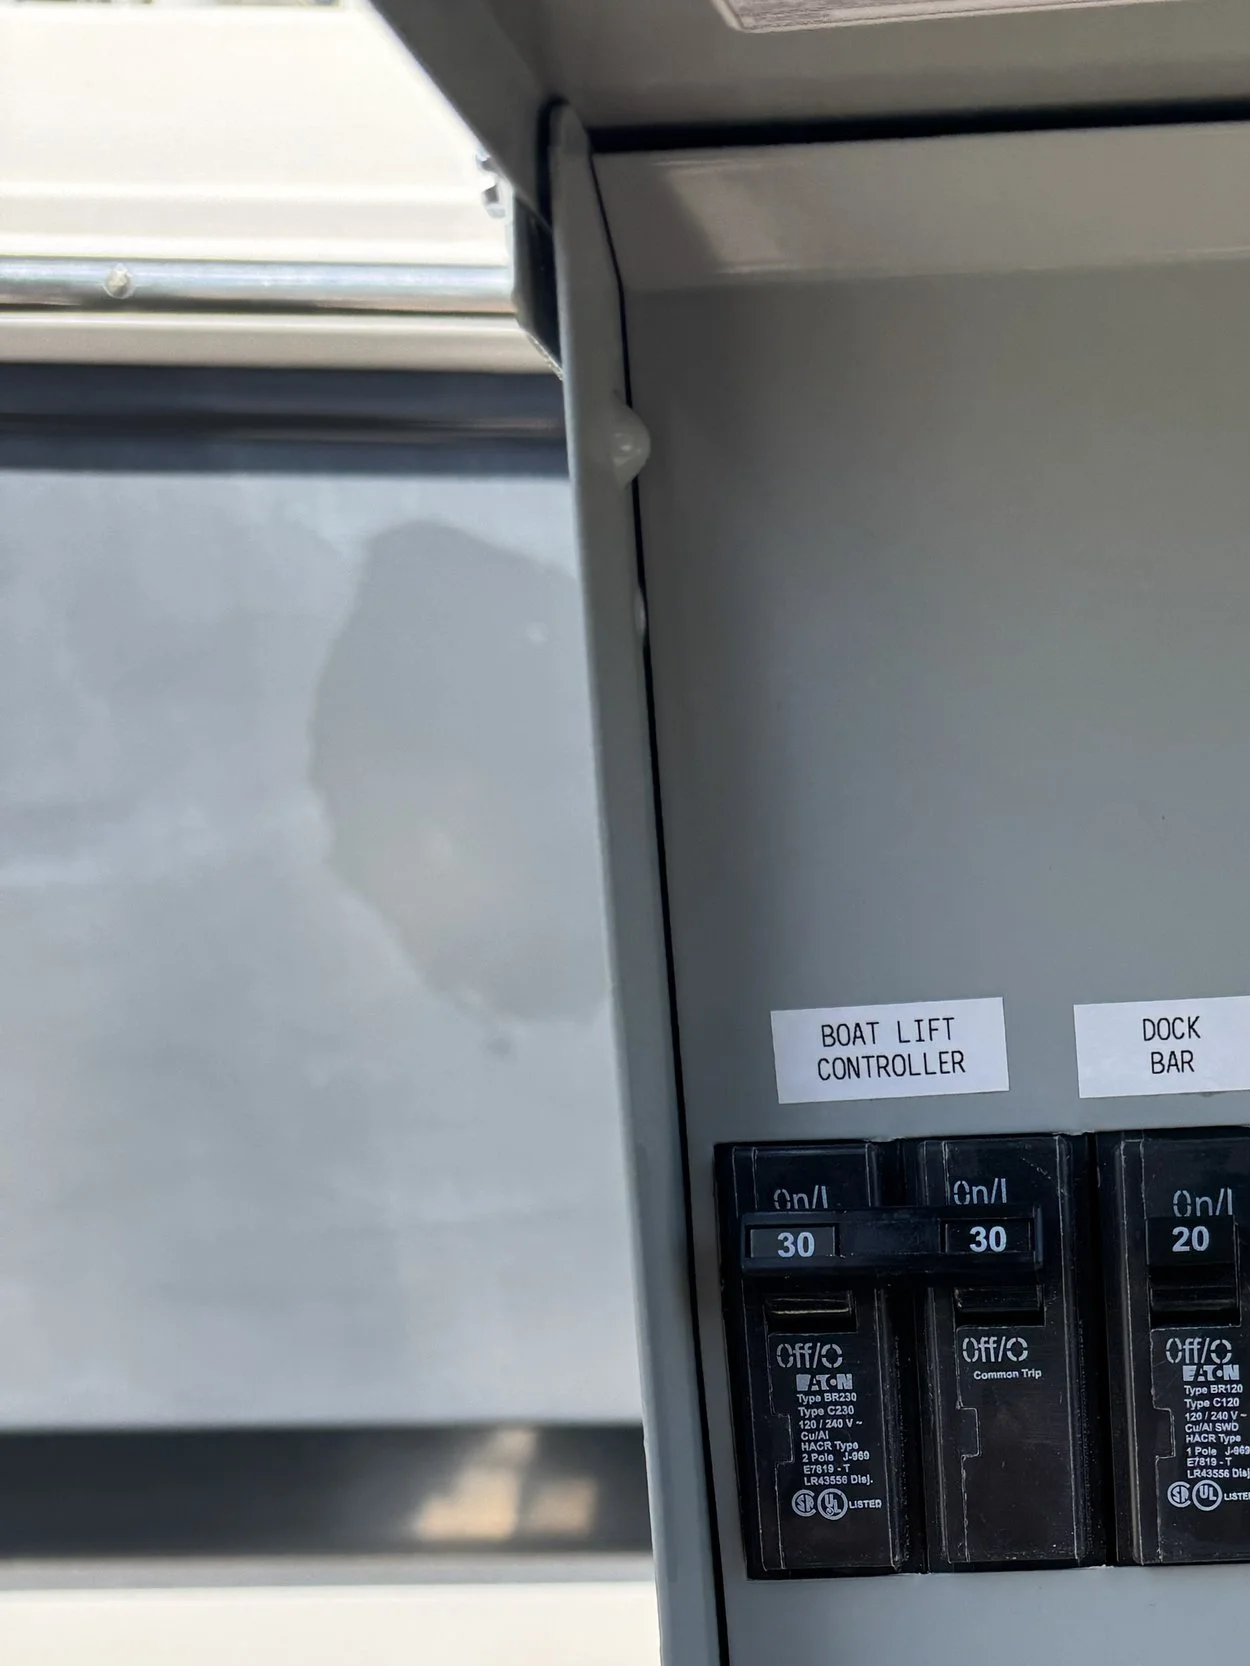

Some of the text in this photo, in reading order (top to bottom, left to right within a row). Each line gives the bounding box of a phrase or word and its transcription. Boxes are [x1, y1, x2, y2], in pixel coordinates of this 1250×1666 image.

[821, 1017, 955, 1047] BOAT LIFT
[1142, 1015, 1201, 1042] DOCK
[817, 1050, 966, 1081] CONTROLLER
[1150, 1050, 1195, 1074] BAR
[777, 1231, 815, 1258] 30
[969, 1225, 1007, 1253] 30
[1172, 1225, 1210, 1252] 20
[973, 1368, 1042, 1380] Common Trip
[1182, 1364, 1240, 1382] EATON
[1183, 1383, 1244, 1397] Type BR120
[796, 1392, 857, 1405] Type BR230
[1183, 1397, 1240, 1410] Type C120
[797, 1405, 855, 1418] Type C230
[1185, 1412, 1202, 1421] 120
[1210, 1411, 1229, 1420] 240
[1230, 1411, 1238, 1420] V
[799, 1420, 817, 1430] 120
[825, 1419, 843, 1428] 240
[845, 1418, 854, 1428] V
[1215, 1422, 1239, 1432] SWD
[1185, 1434, 1242, 1445] HACR Type
[801, 1441, 859, 1452] HACR Type
[1186, 1447, 1192, 1456] 1
[1195, 1446, 1217, 1456] Pole
[802, 1450, 870, 1463] 2 Pole J-969
[1186, 1457, 1217, 1467] E7819
[1224, 1457, 1233, 1466] T
[803, 1464, 834, 1474] E7819
[842, 1463, 851, 1473] T
[1187, 1469, 1229, 1479] LR43556
[848, 1499, 882, 1509] LISTED
